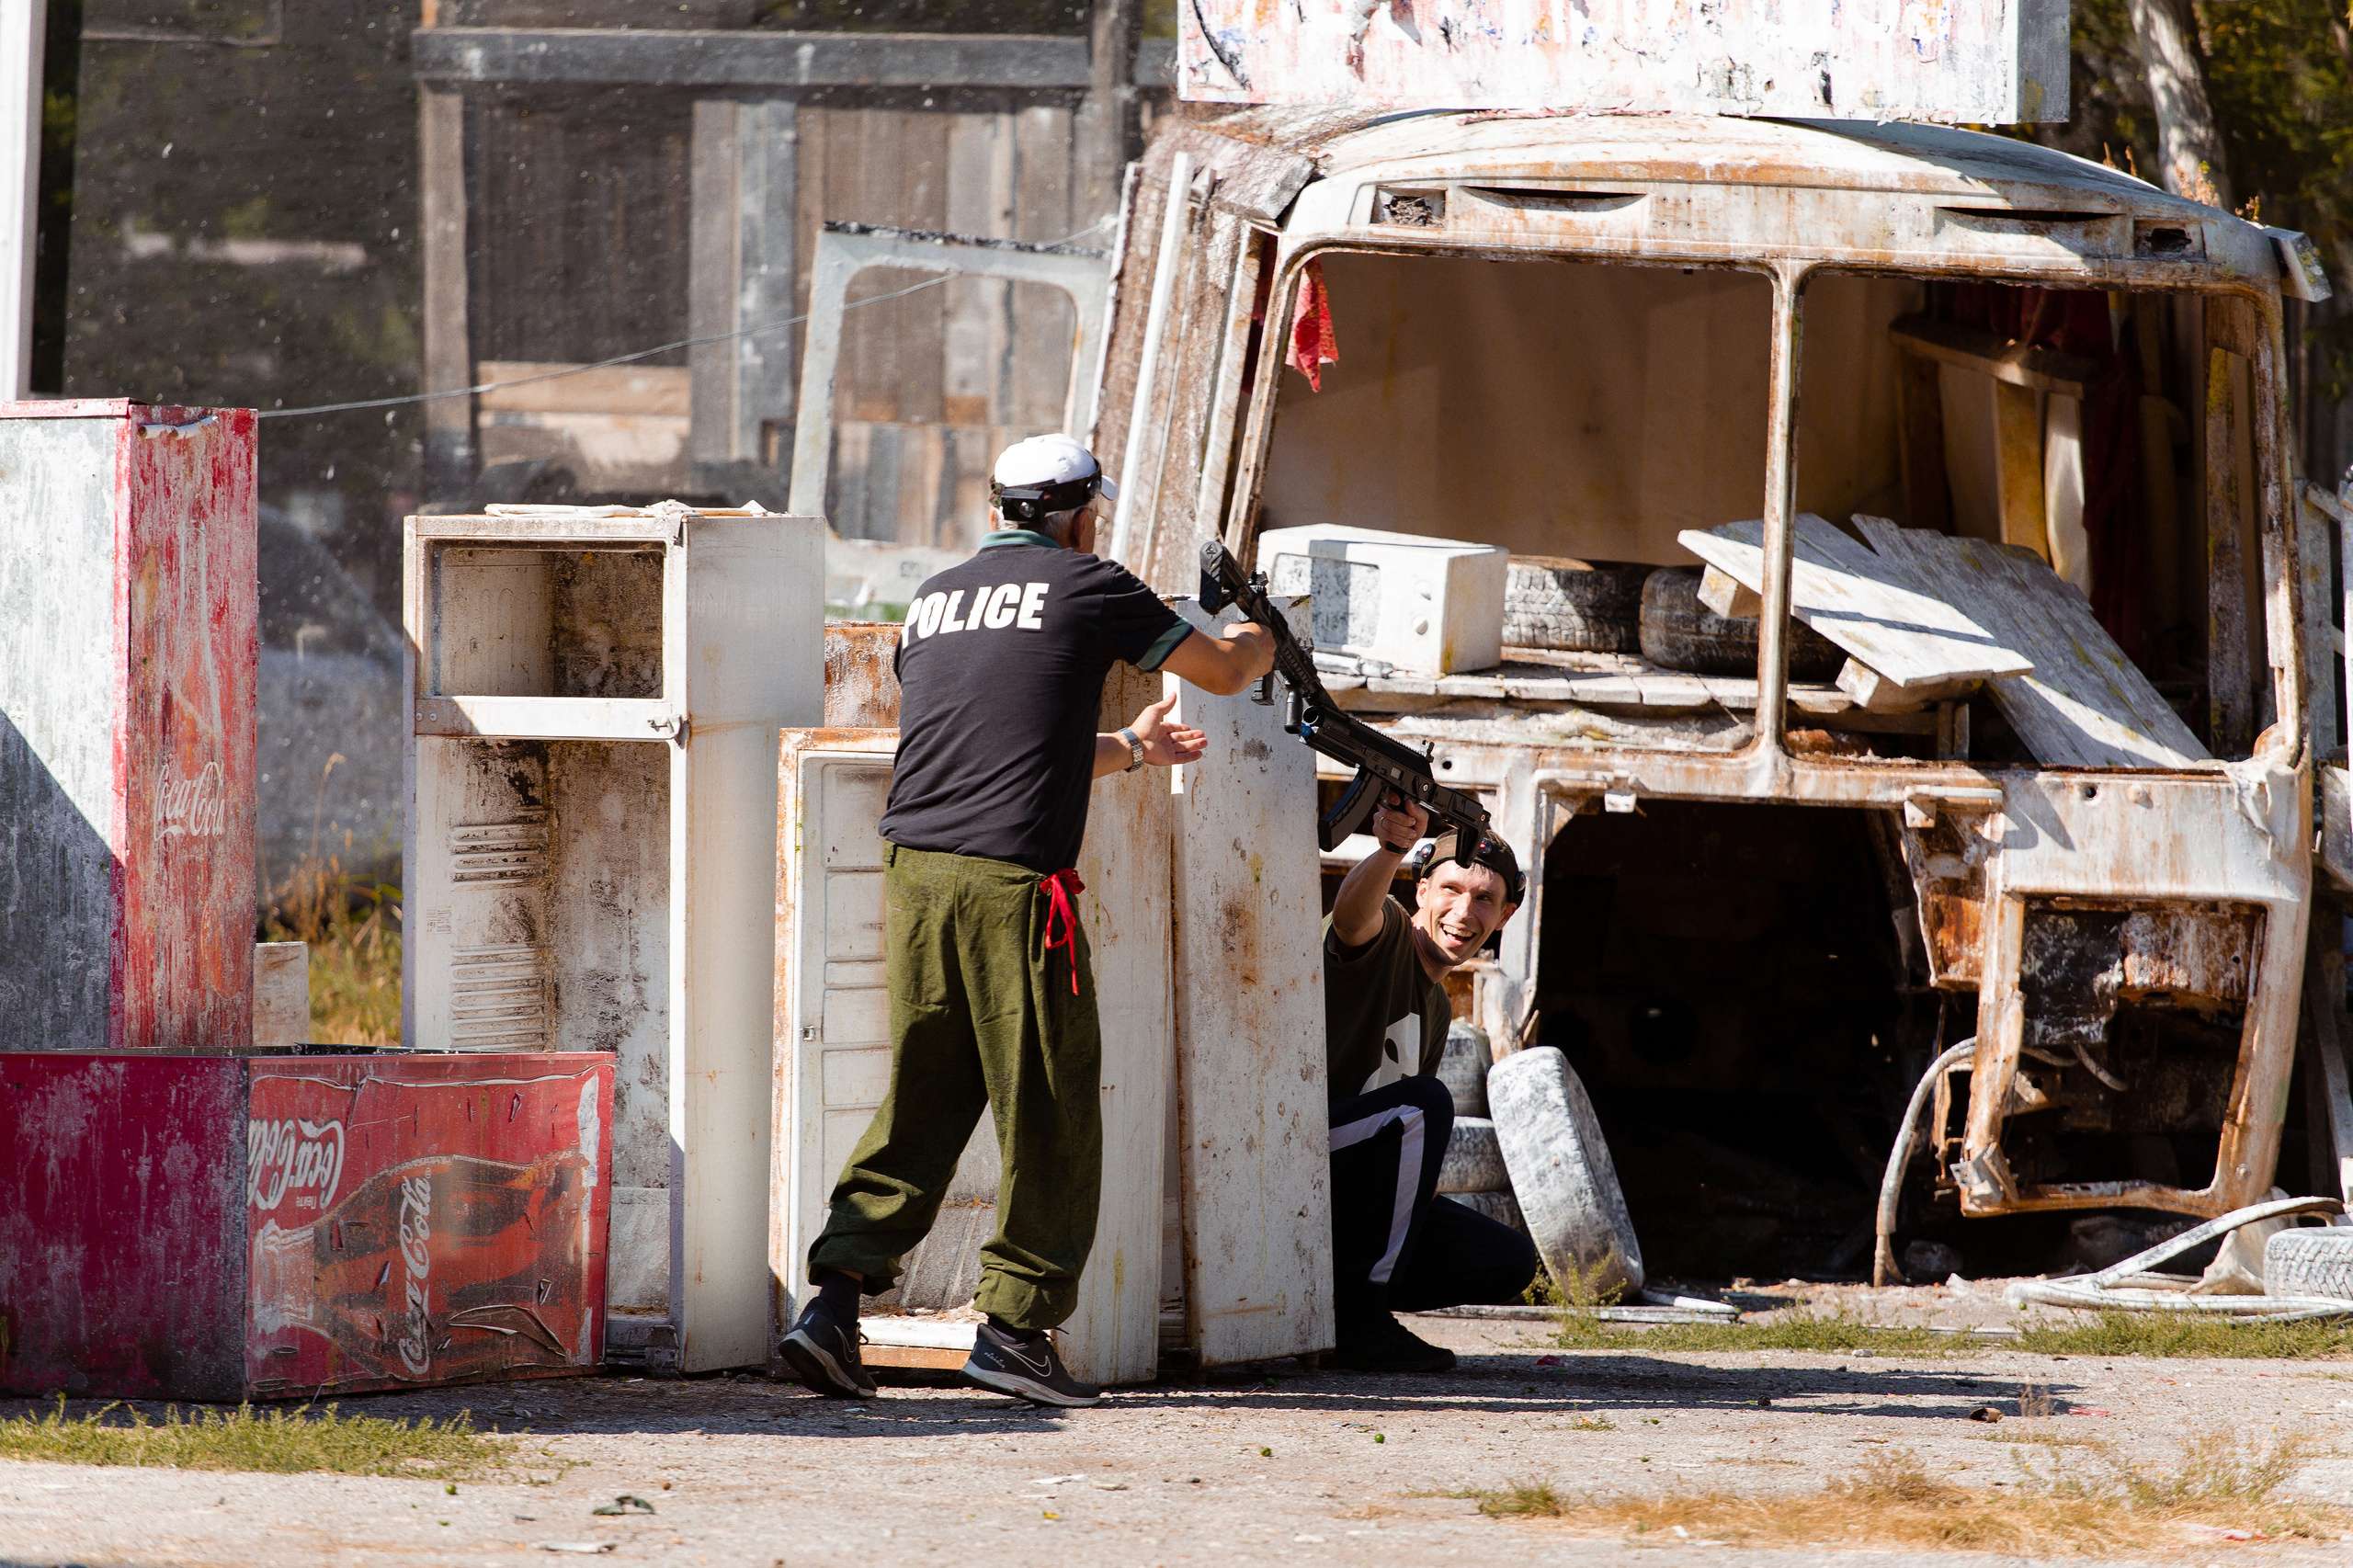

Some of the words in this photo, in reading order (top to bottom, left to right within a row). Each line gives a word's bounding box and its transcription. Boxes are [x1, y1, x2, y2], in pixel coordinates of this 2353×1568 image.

[902, 582, 1050, 649] POLICE
[154, 759, 226, 841] Coca-Cola
[399, 1176, 431, 1375] Coca-Cola
